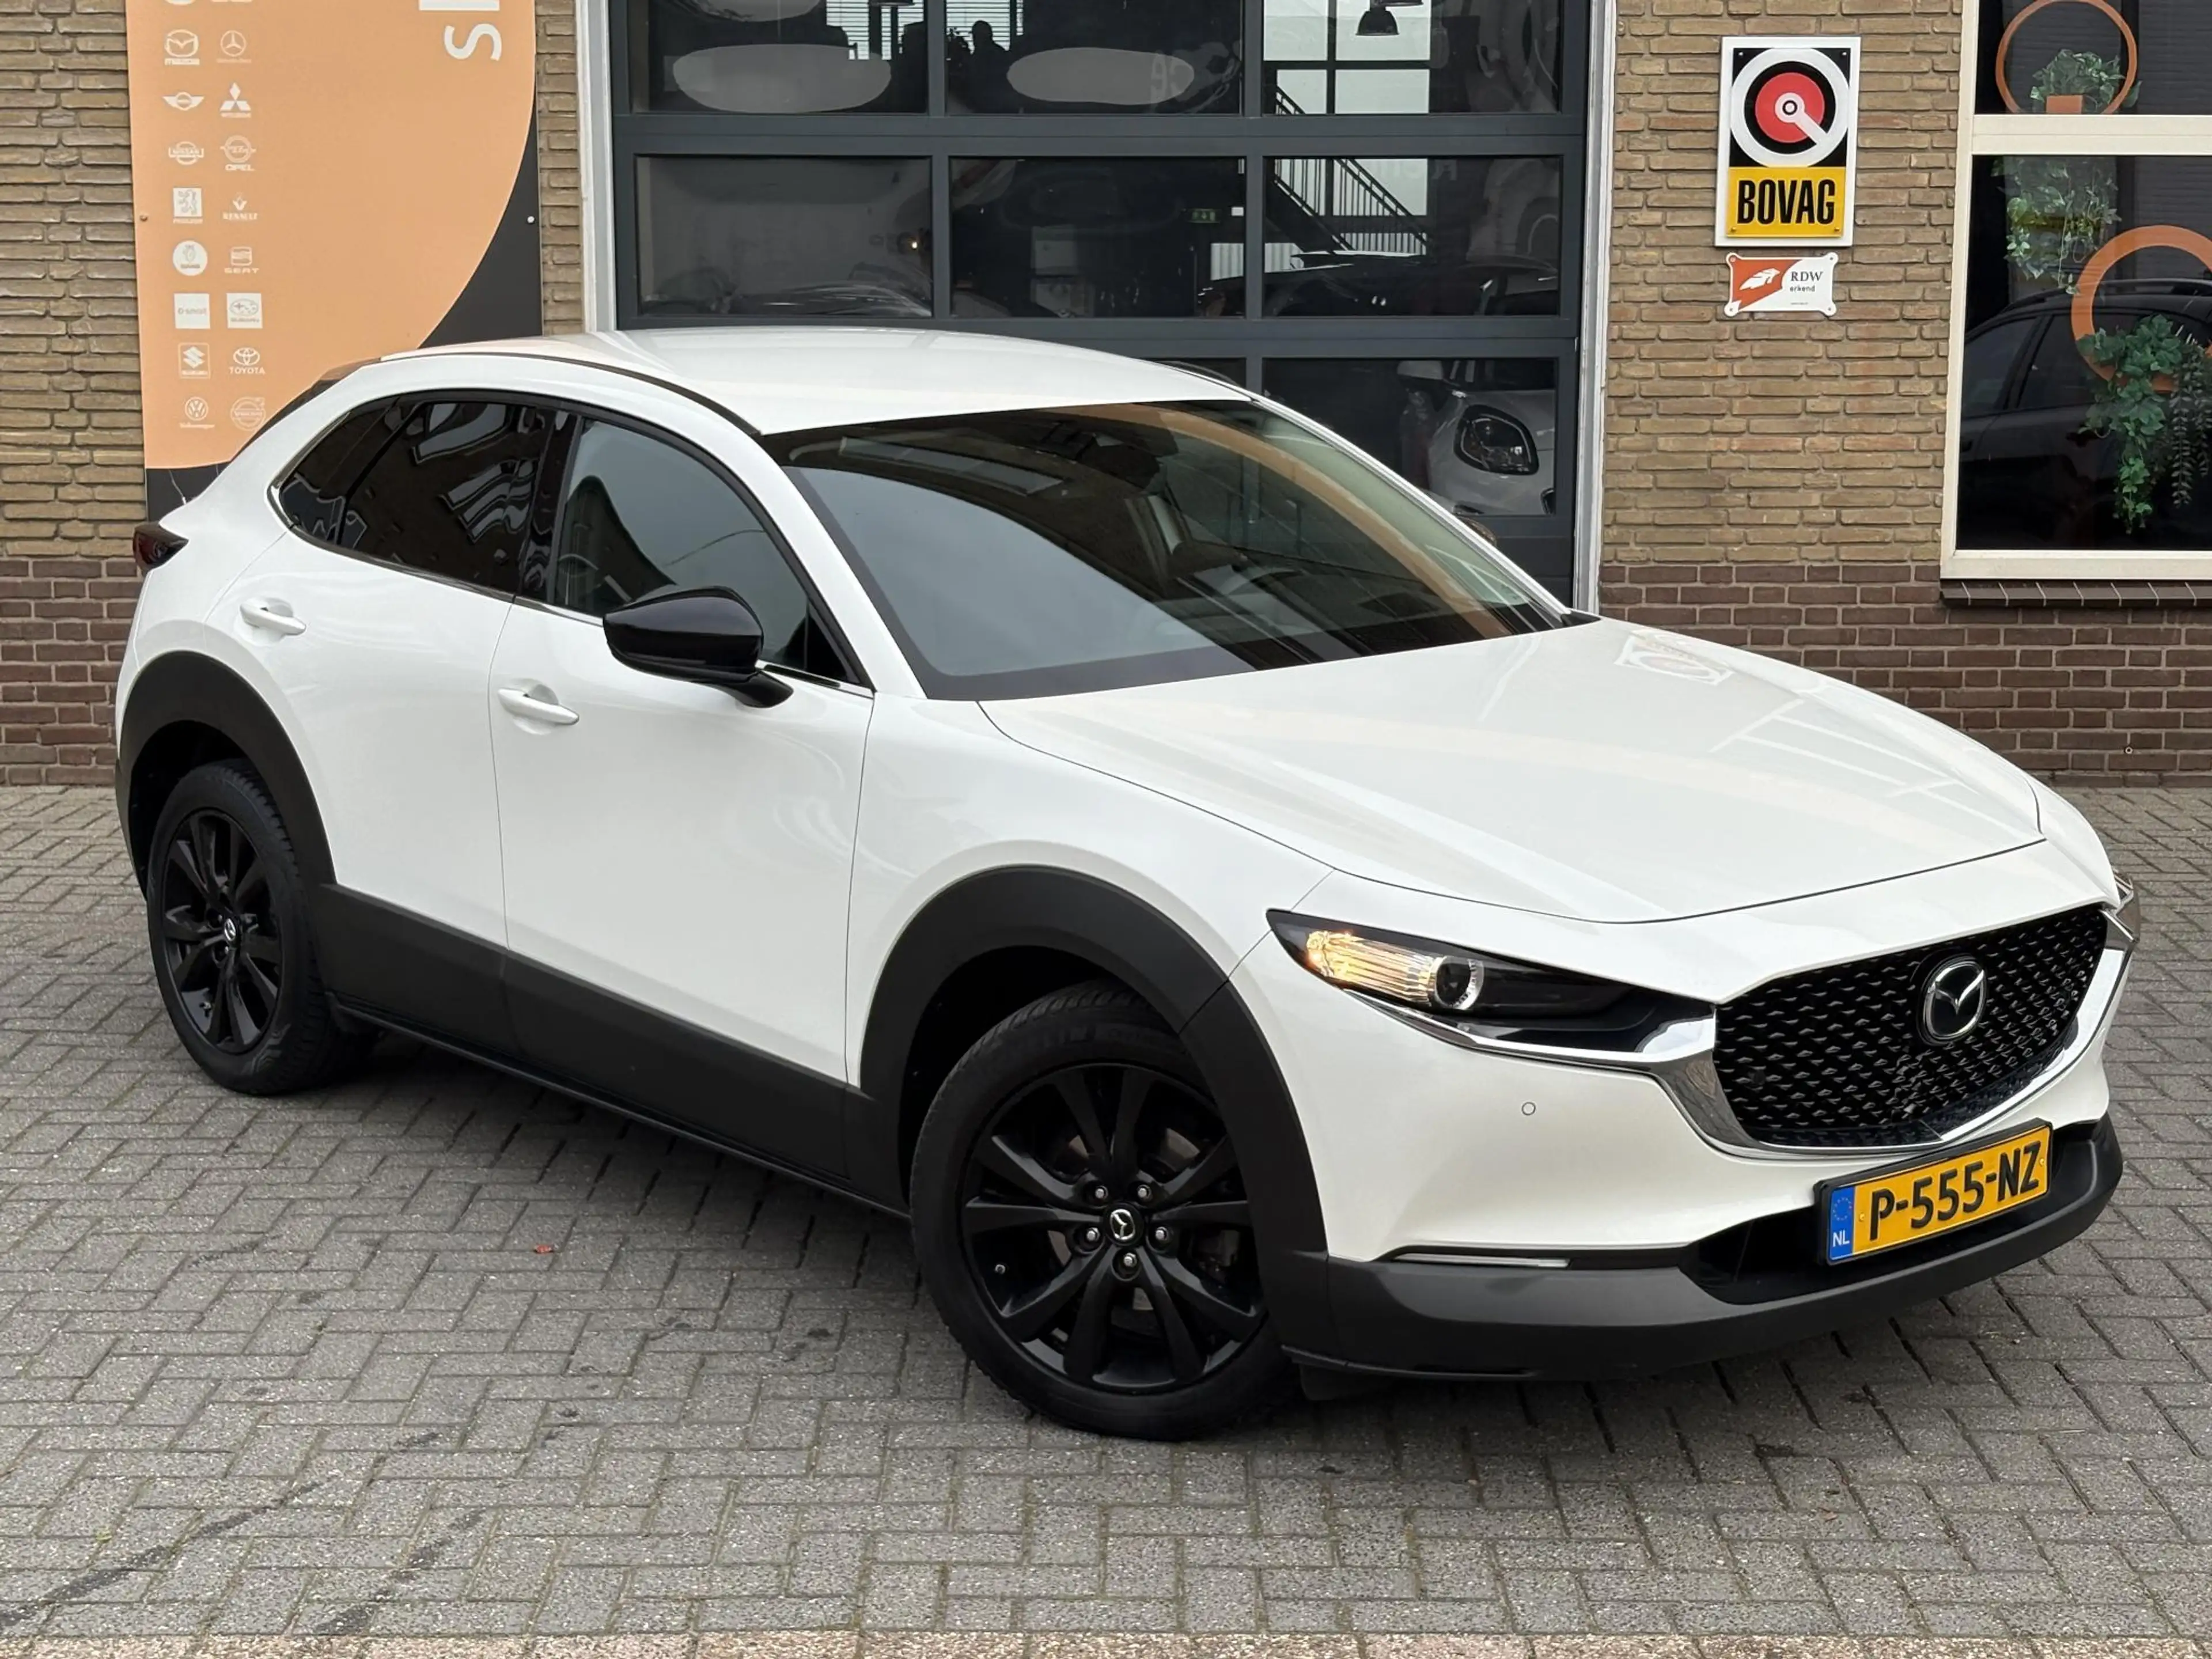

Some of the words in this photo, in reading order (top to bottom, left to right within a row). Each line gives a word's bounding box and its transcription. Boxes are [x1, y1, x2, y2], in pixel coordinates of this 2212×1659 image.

[1737, 179, 1836, 225] BOVAG
[1790, 271, 1823, 282] RDW
[228, 366, 266, 375] TOYOTA
[1869, 1140, 2042, 1241] P-555-NZ
[1832, 1229, 1850, 1247] NL
